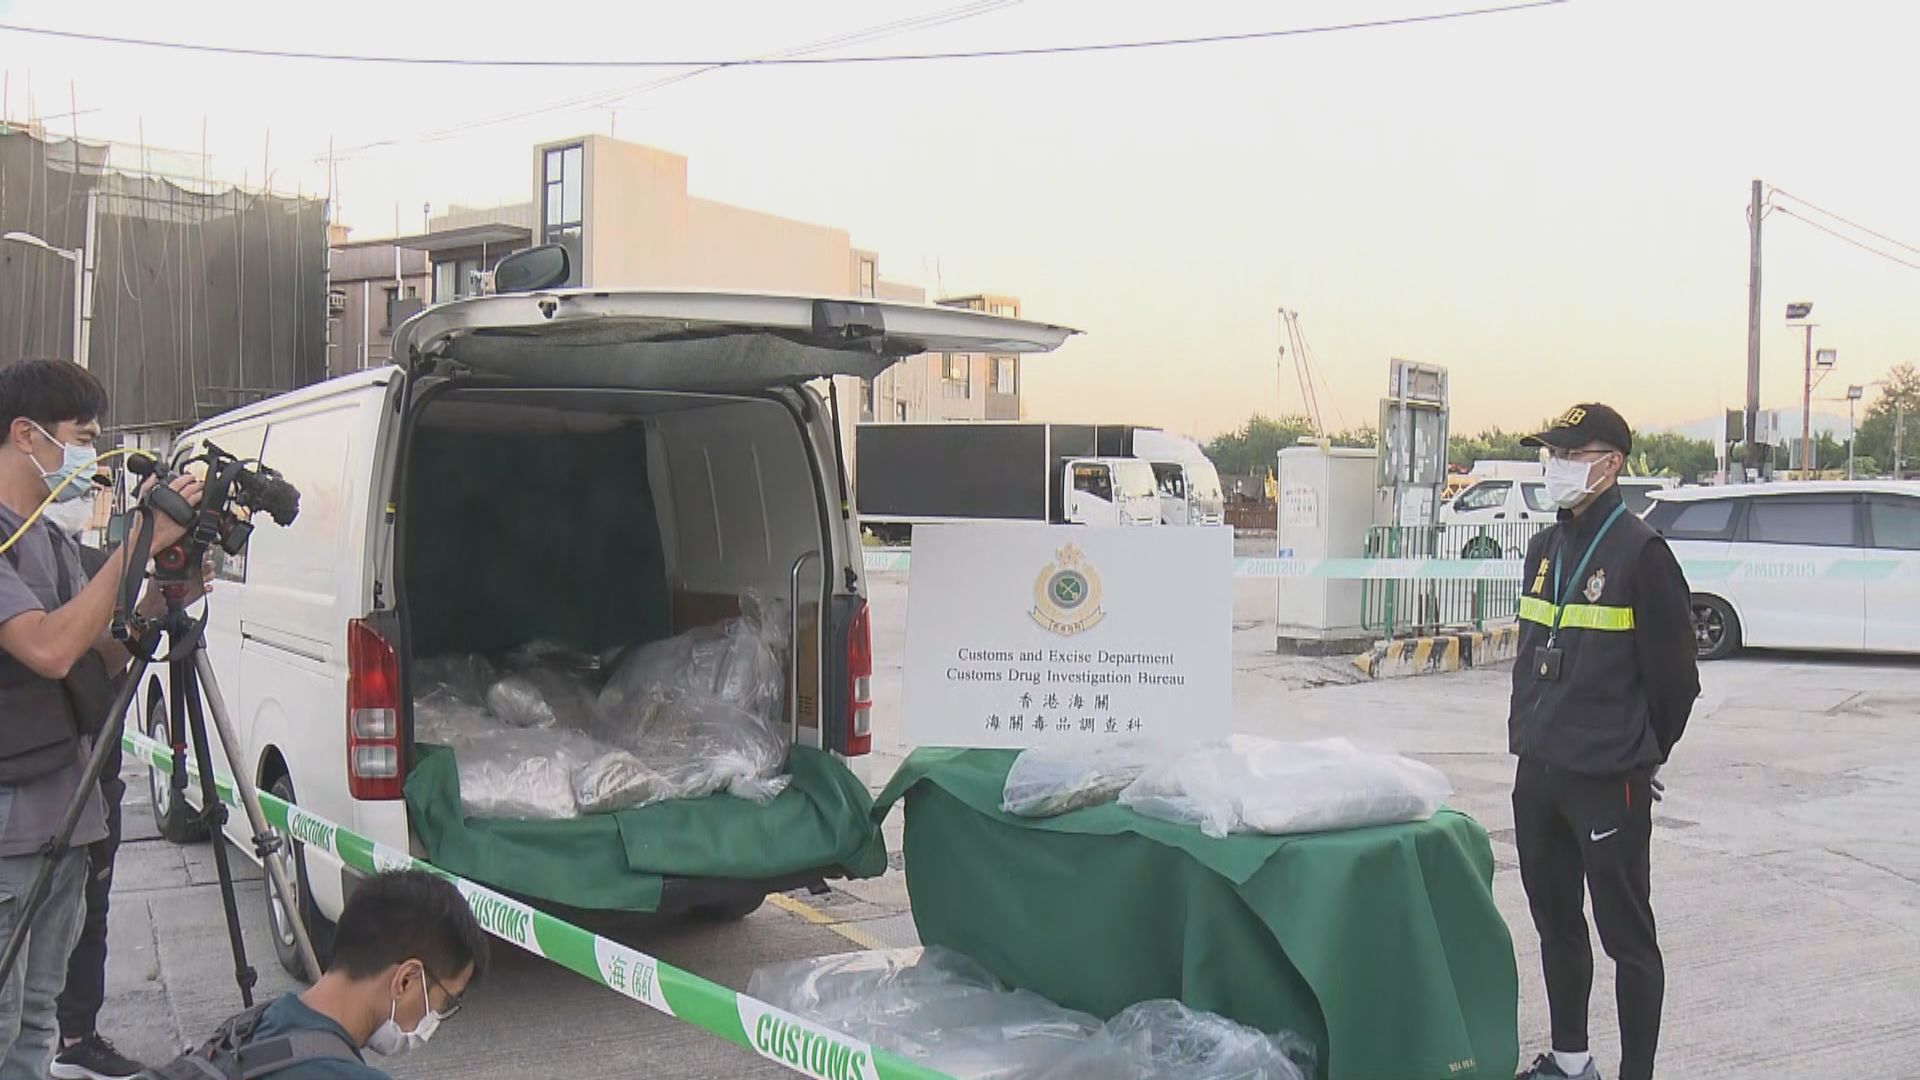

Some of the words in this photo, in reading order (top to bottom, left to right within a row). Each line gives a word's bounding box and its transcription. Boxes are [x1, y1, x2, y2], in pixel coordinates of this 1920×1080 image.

[958, 648, 1014, 661] Customs
[1019, 649, 1043, 662] and
[1049, 649, 1092, 663] Excise
[1098, 650, 1173, 667] Department
[946, 668, 1002, 681] Customs
[1008, 668, 1041, 685] Drug
[1047, 669, 1131, 686] Investigation
[1138, 671, 1185, 685] Bureau
[1018, 691, 1109, 712] 香港海關
[985, 713, 1143, 734] 海關毒品調查科
[291, 813, 334, 850] CUSTOMS
[608, 954, 654, 1000] 海關
[755, 1013, 867, 1080] CUSTOMS
